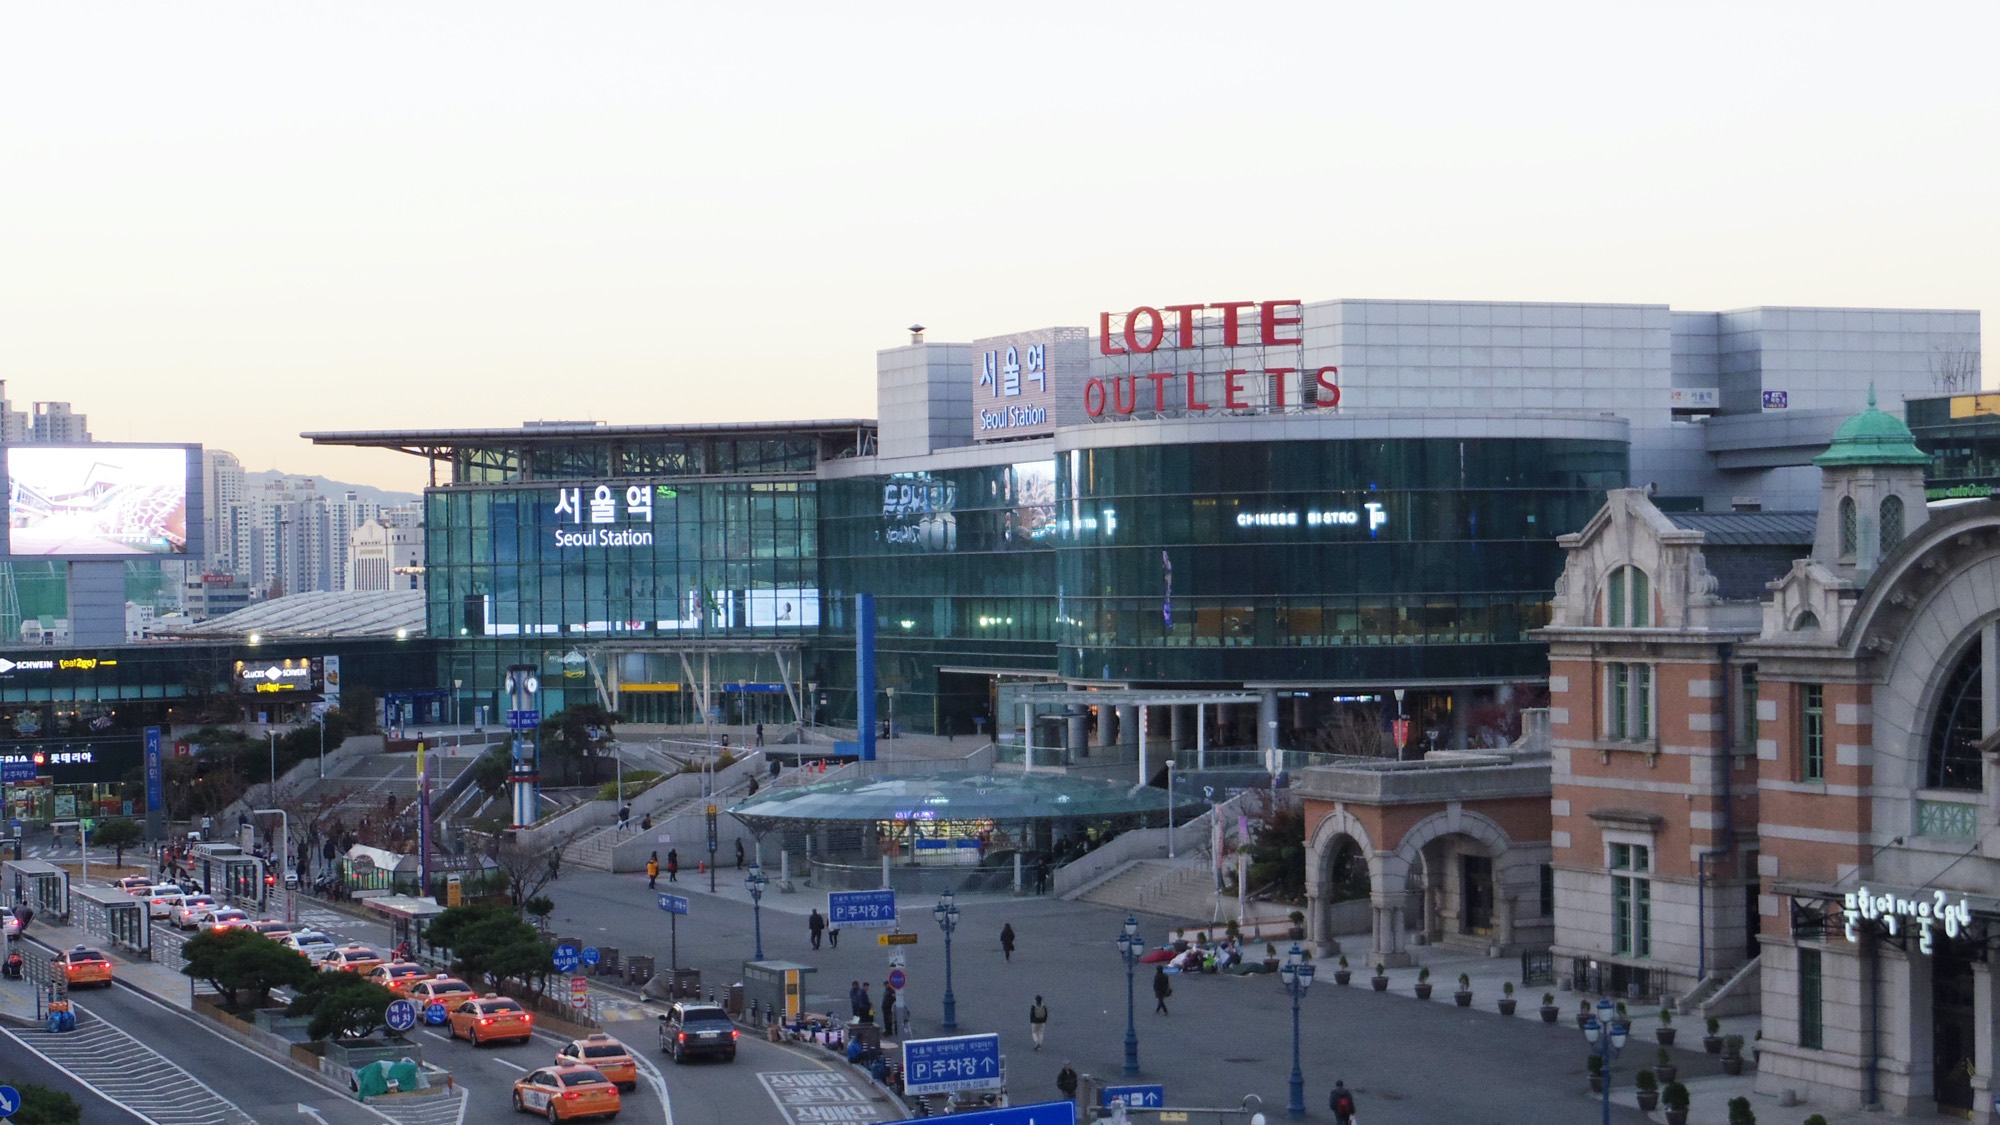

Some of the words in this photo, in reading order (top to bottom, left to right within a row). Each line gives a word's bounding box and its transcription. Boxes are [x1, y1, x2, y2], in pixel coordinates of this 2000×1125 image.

[1100, 300, 1301, 354] LOTTE
[980, 344, 1045, 397] 서울역
[1084, 366, 1340, 416] OUTLETS
[980, 406, 1009, 430] Seoul
[1009, 403, 1047, 427] Station
[554, 485, 652, 523] 서울역
[1237, 513, 1297, 526] CHINESE
[1308, 512, 1357, 524] BISTRO
[555, 529, 596, 546] Seoul
[600, 528, 652, 546] Station
[16, 660, 53, 669] SCHWEIN
[50, 752, 92, 764] 롯데리아
[836, 907, 844, 918] P
[848, 904, 880, 918] 주차장
[390, 1003, 410, 1014] 택시
[391, 1013, 411, 1023] 하차
[911, 1046, 933, 1054] 서울역
[916, 1063, 926, 1078] P
[932, 1057, 977, 1077] 주차장
